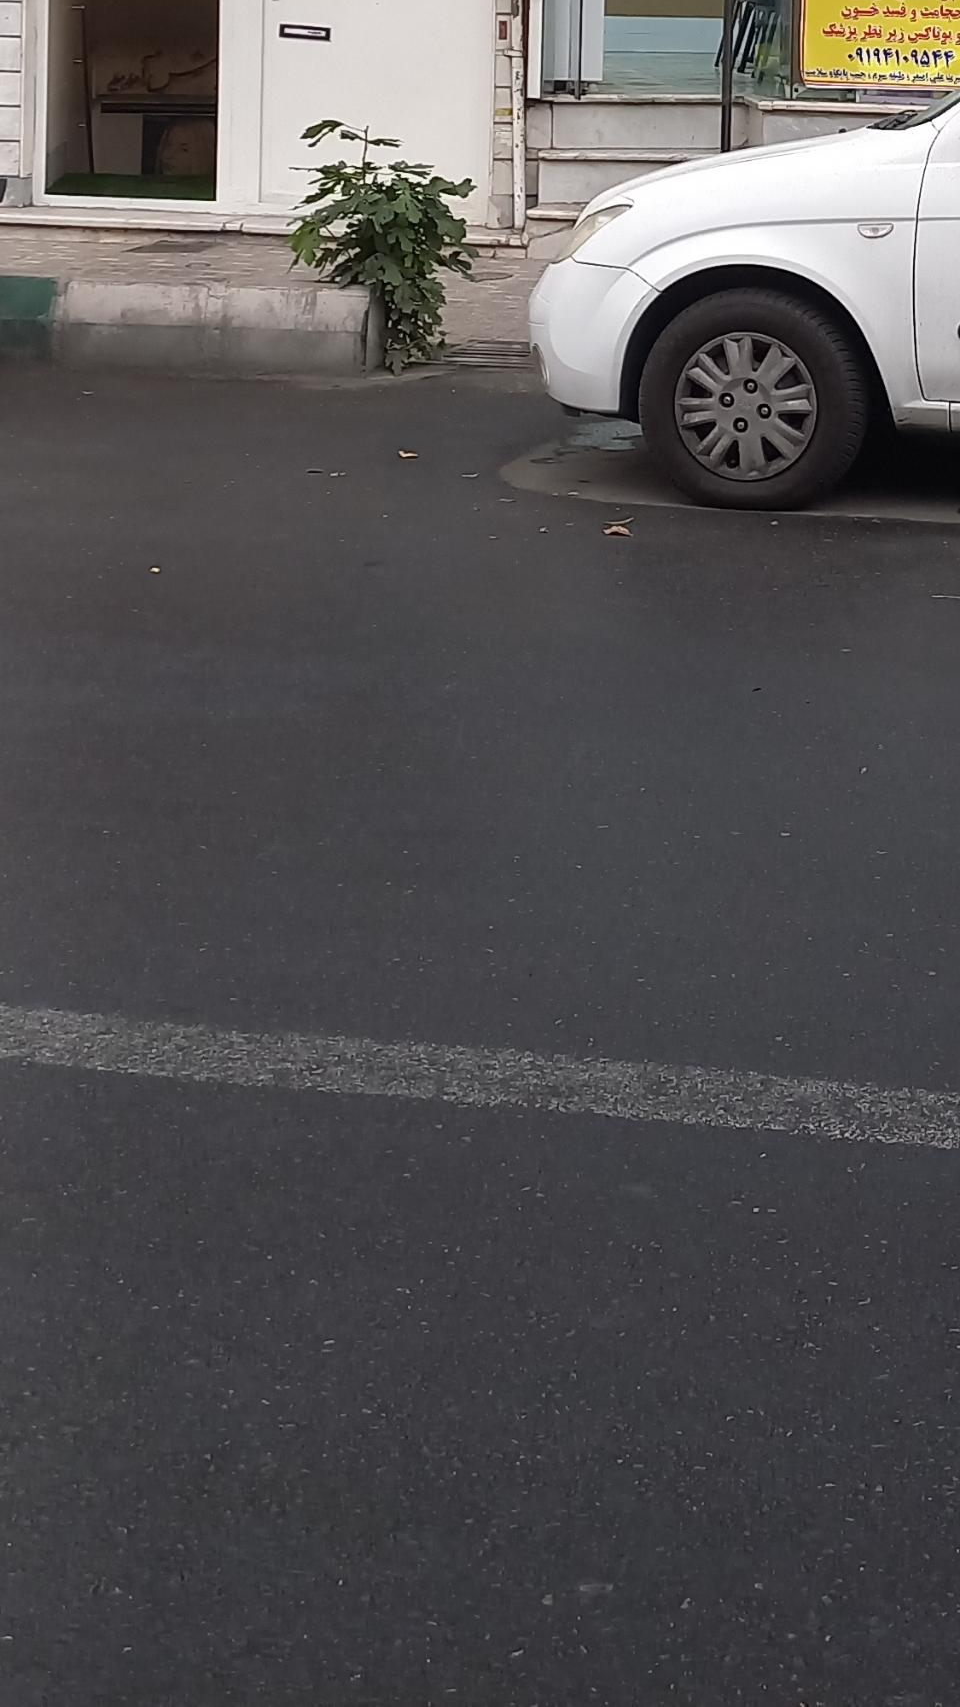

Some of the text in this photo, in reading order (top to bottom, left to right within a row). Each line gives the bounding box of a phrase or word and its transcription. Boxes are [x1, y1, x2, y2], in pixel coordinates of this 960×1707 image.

[841, 3, 879, 20] خون
[910, 10, 917, 21] و
[822, 23, 857, 42] پزشک
[860, 23, 882, 41] نظر
[886, 28, 905, 43] زیر
[907, 27, 953, 45] بوتاکس
[847, 46, 955, 69] ۰۹۱۹۴۱۰۹۵۴۴
